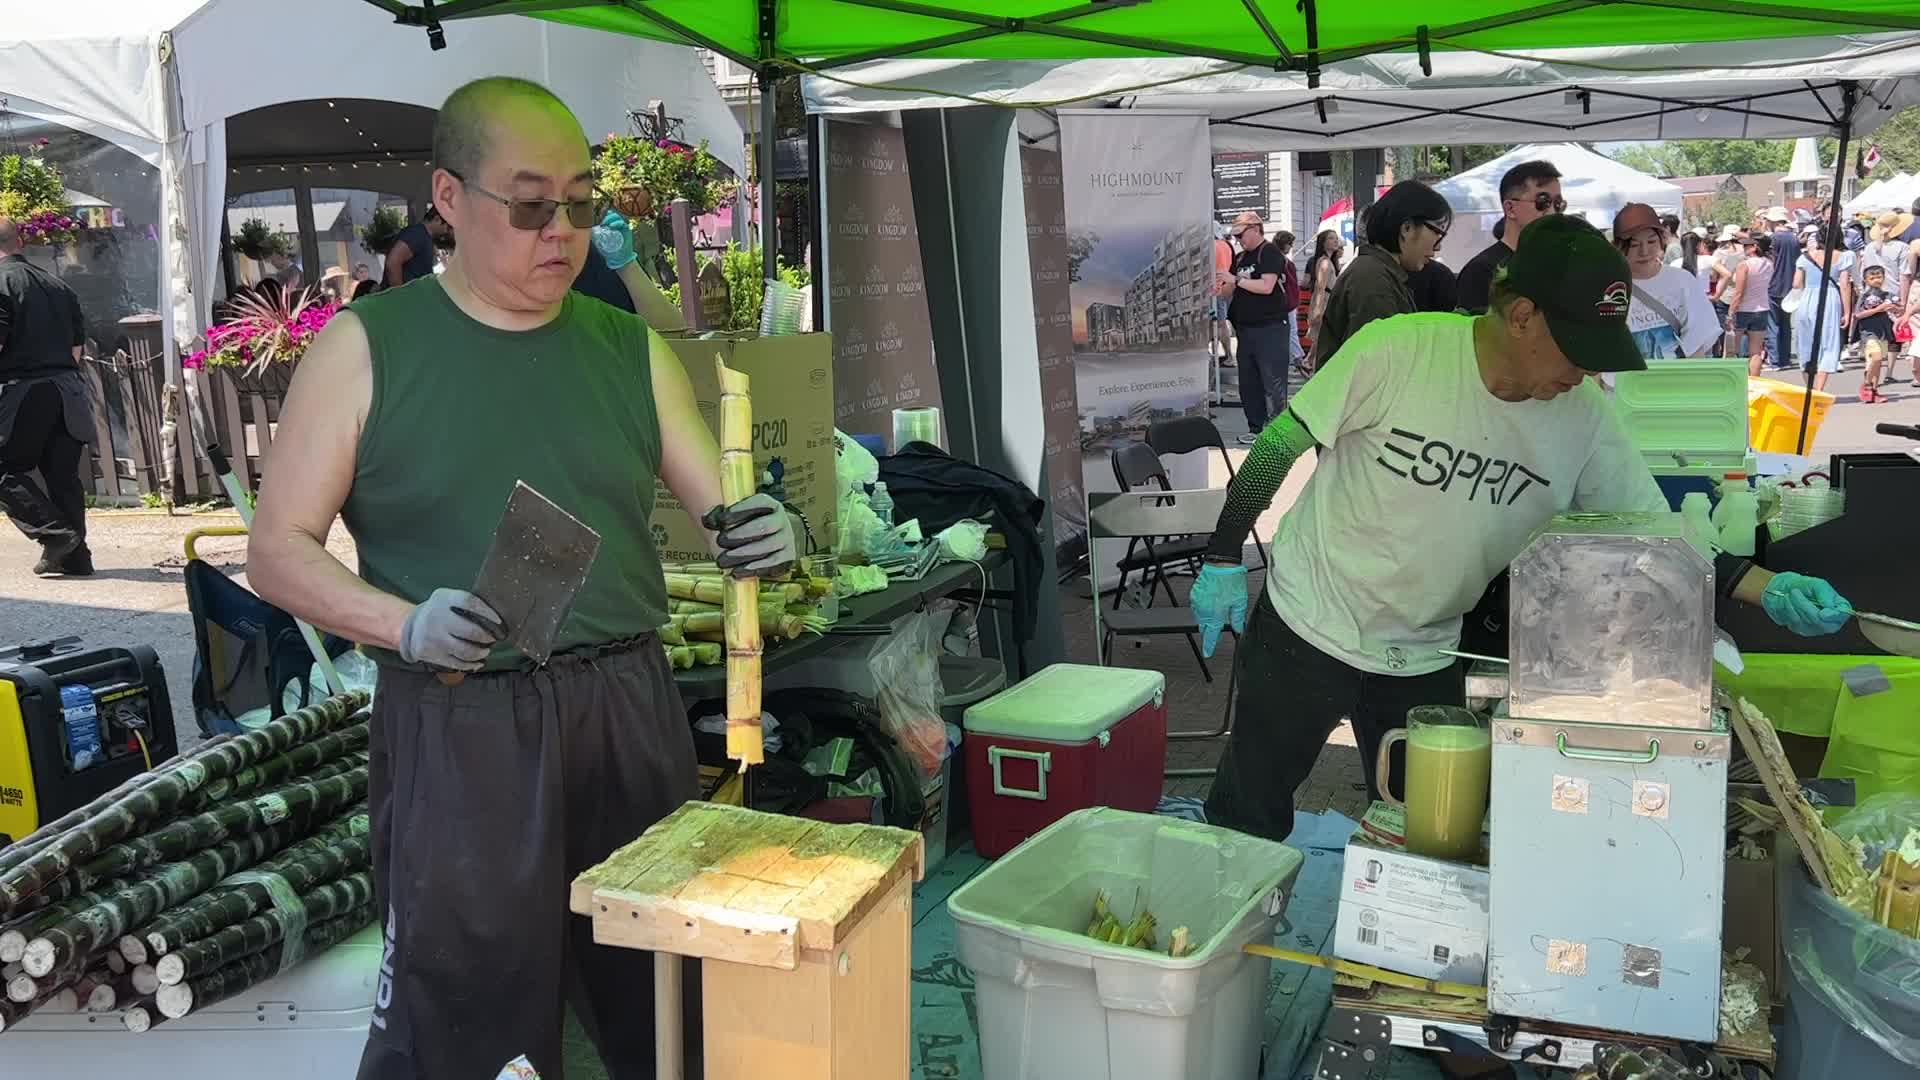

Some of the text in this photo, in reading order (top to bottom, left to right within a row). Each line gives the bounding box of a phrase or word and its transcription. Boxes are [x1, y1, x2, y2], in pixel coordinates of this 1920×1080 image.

[1090, 171, 1184, 188] HIGHMOUNT
[1376, 427, 1551, 506] ESPRIT
[666, 551, 713, 561] RECYCLA
